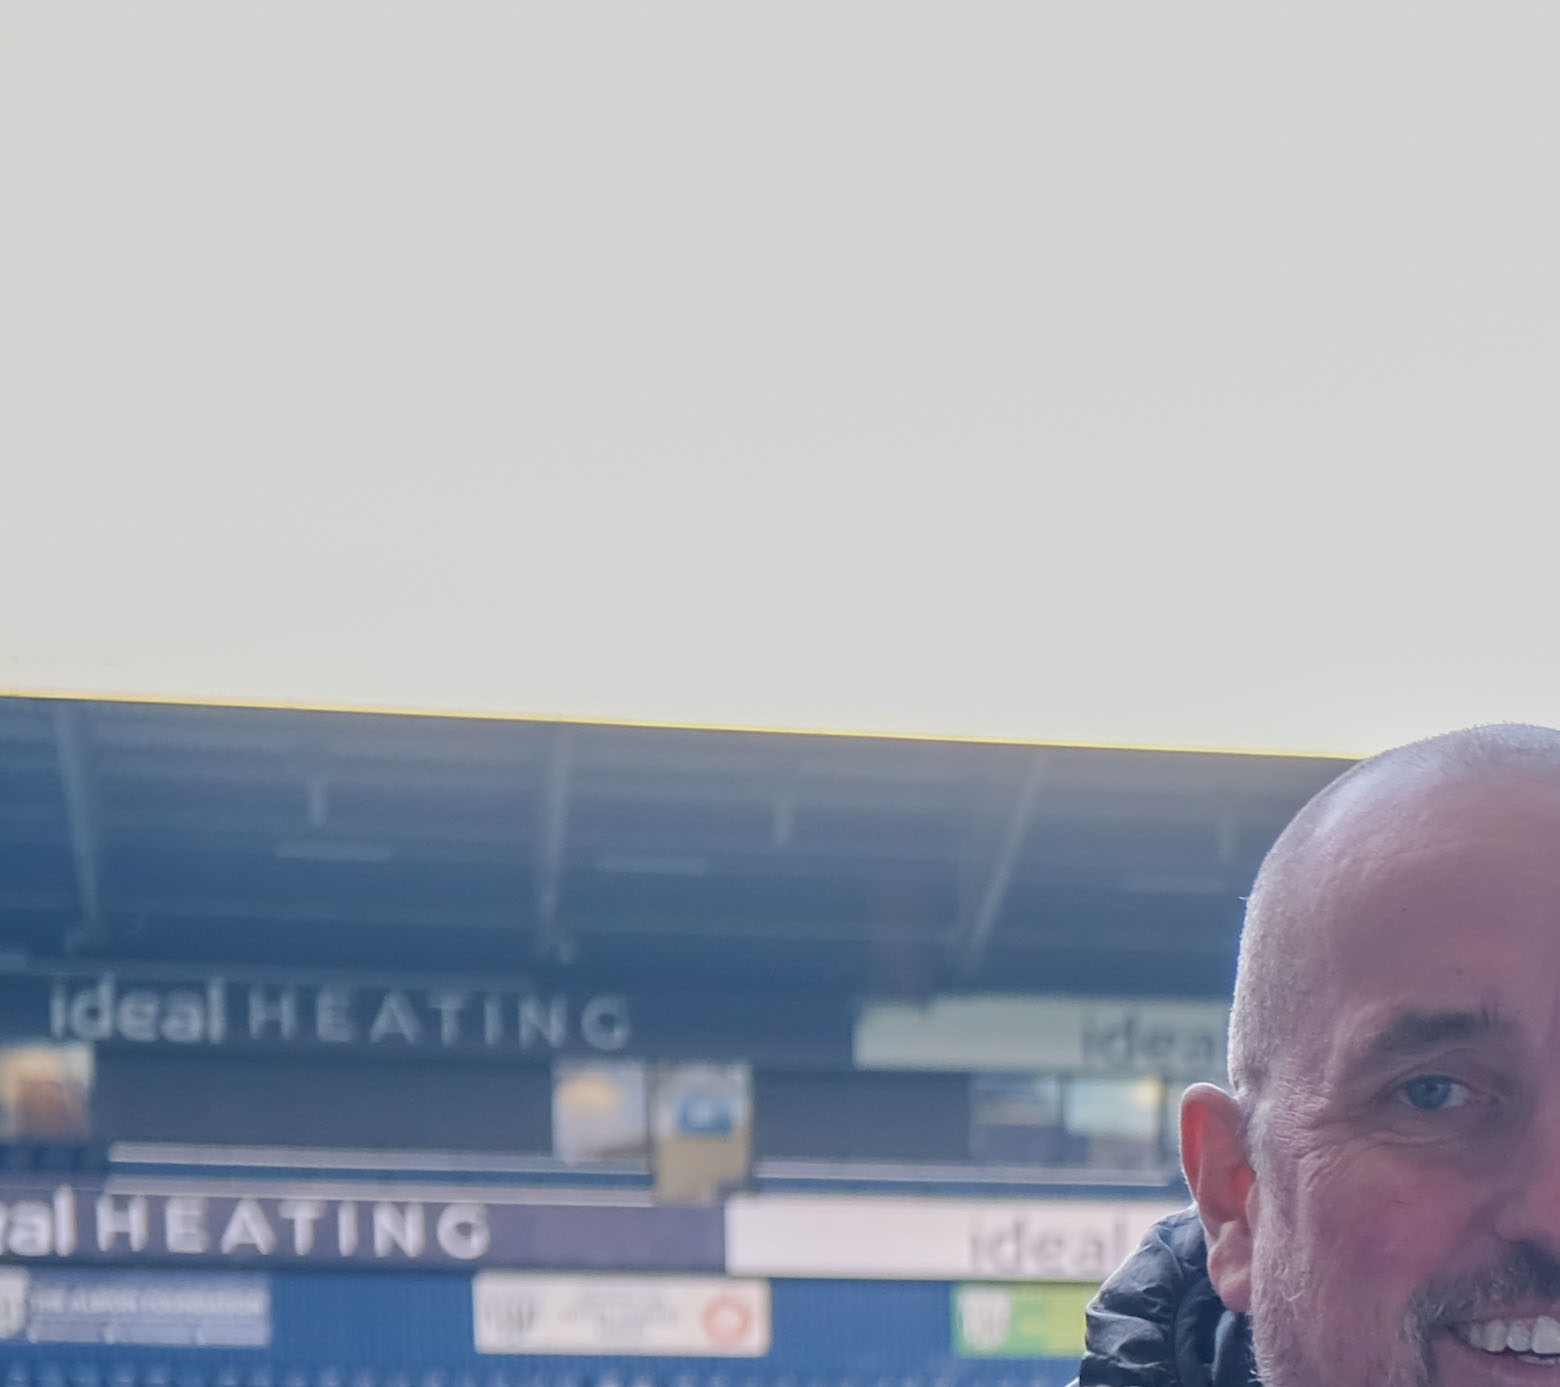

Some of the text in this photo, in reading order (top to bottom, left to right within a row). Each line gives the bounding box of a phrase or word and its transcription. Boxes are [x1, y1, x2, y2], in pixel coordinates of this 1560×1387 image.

[50, 973, 633, 1050] ideal HEATING
[0, 1183, 491, 1261] al HEATING
